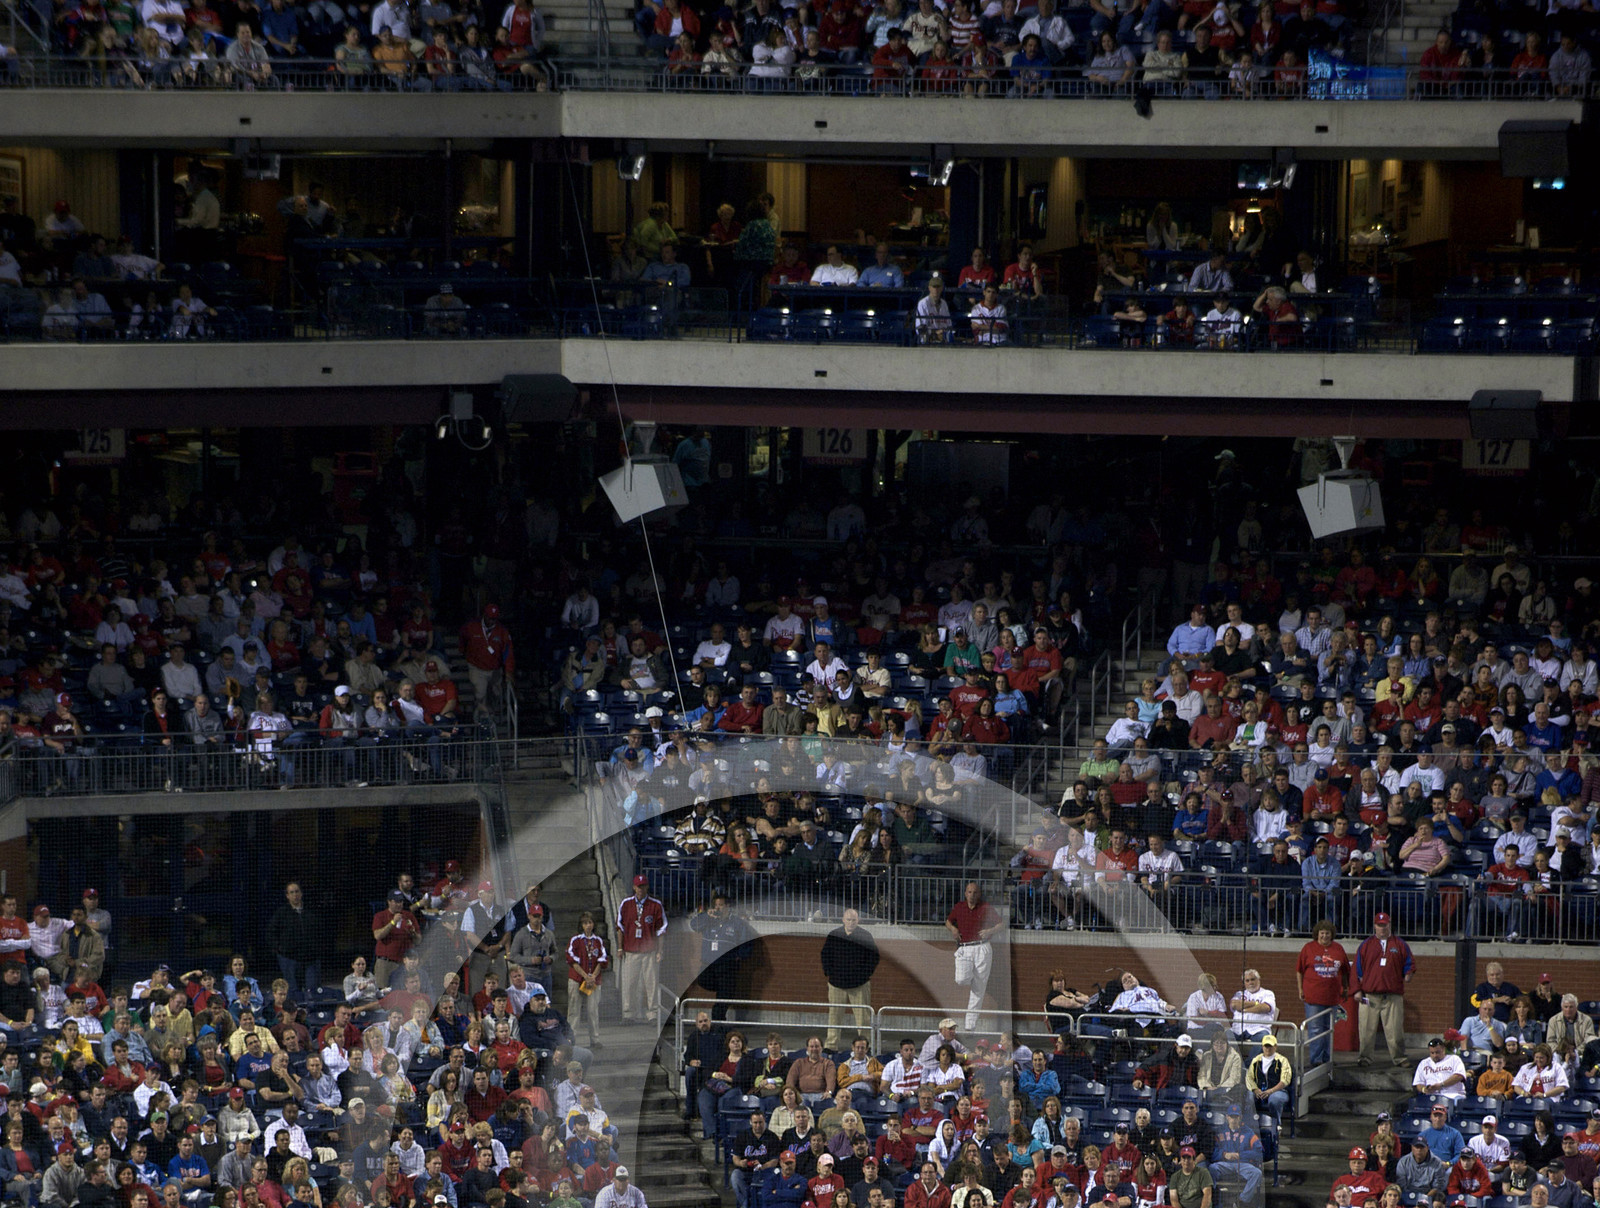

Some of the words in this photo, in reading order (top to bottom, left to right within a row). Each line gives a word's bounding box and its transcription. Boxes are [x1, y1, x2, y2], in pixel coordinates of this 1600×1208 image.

[817, 428, 853, 454] 126
[1478, 439, 1514, 465] 127
[1423, 1066, 1453, 1076] Phillies
[744, 1144, 768, 1157] Mets
